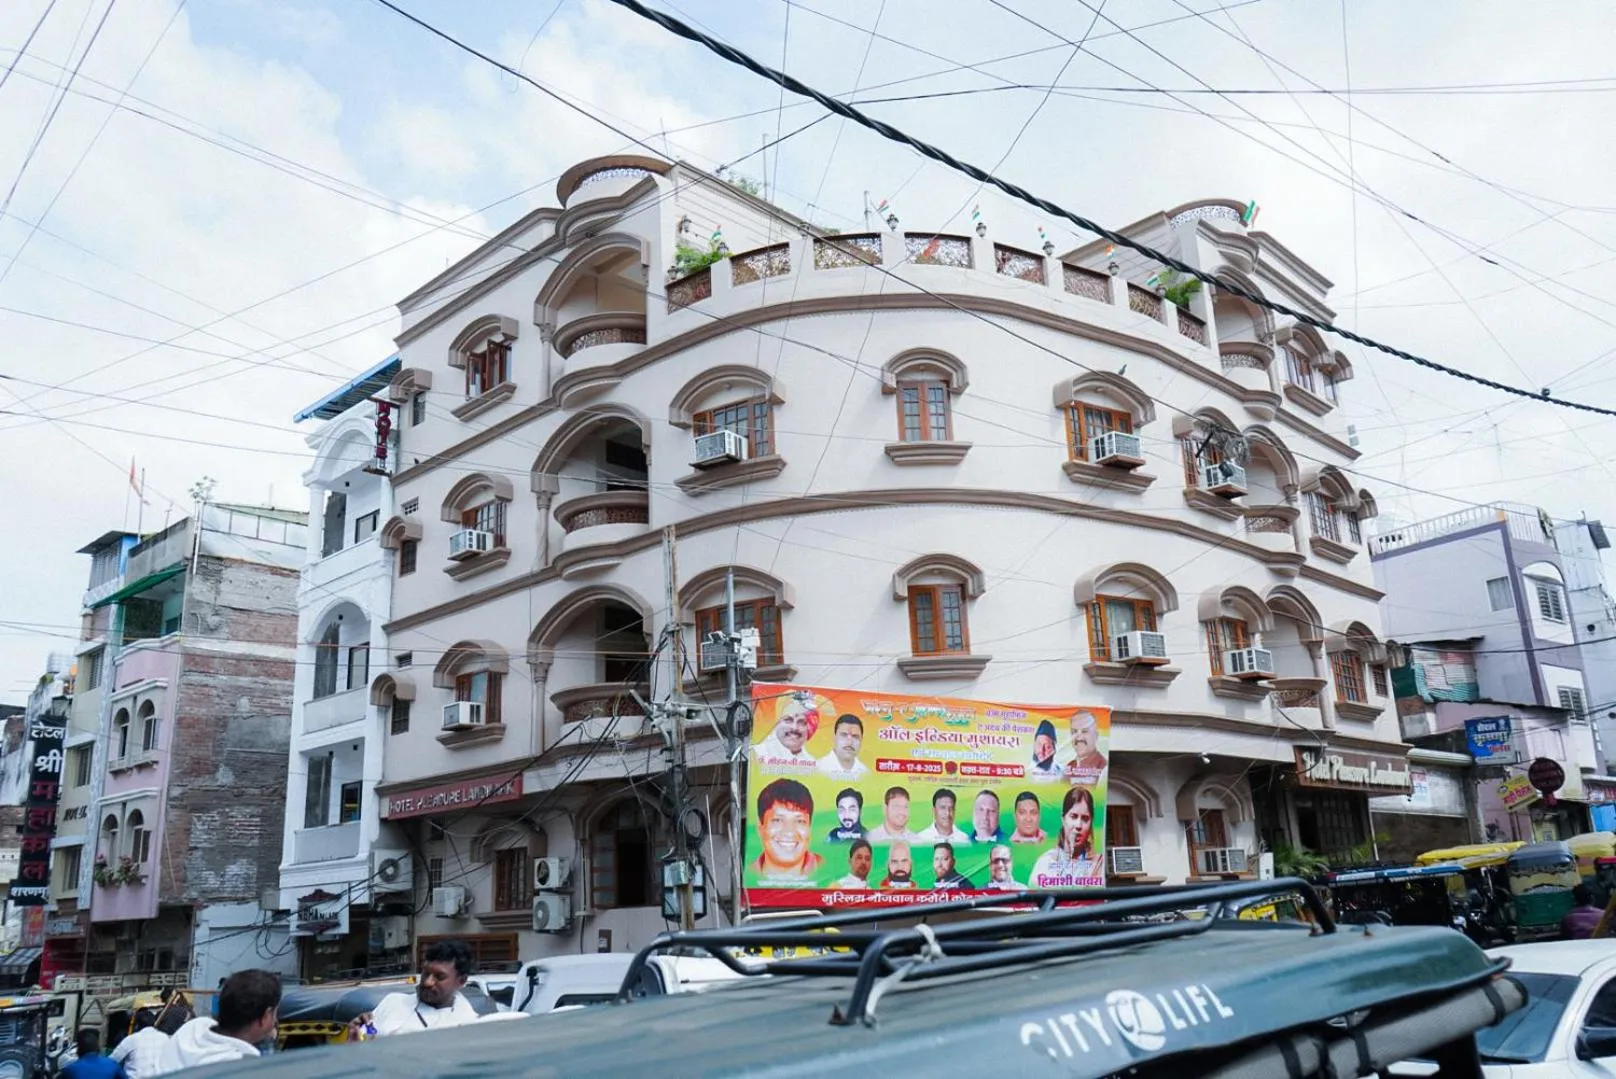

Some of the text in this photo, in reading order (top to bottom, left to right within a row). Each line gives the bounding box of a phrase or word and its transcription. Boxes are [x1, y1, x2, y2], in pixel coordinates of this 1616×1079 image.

[879, 725, 910, 741] ऑल
[967, 733, 1021, 749] मुशायरा
[34, 748, 63, 773] श्री
[389, 798, 414, 813] HOTEL
[1037, 873, 1073, 887] हिमांशी
[821, 891, 866, 905] मुस्लिम
[869, 890, 912, 903] नौजवान
[916, 890, 950, 903] कमेटी
[1020, 1007, 1112, 1058] CITY
